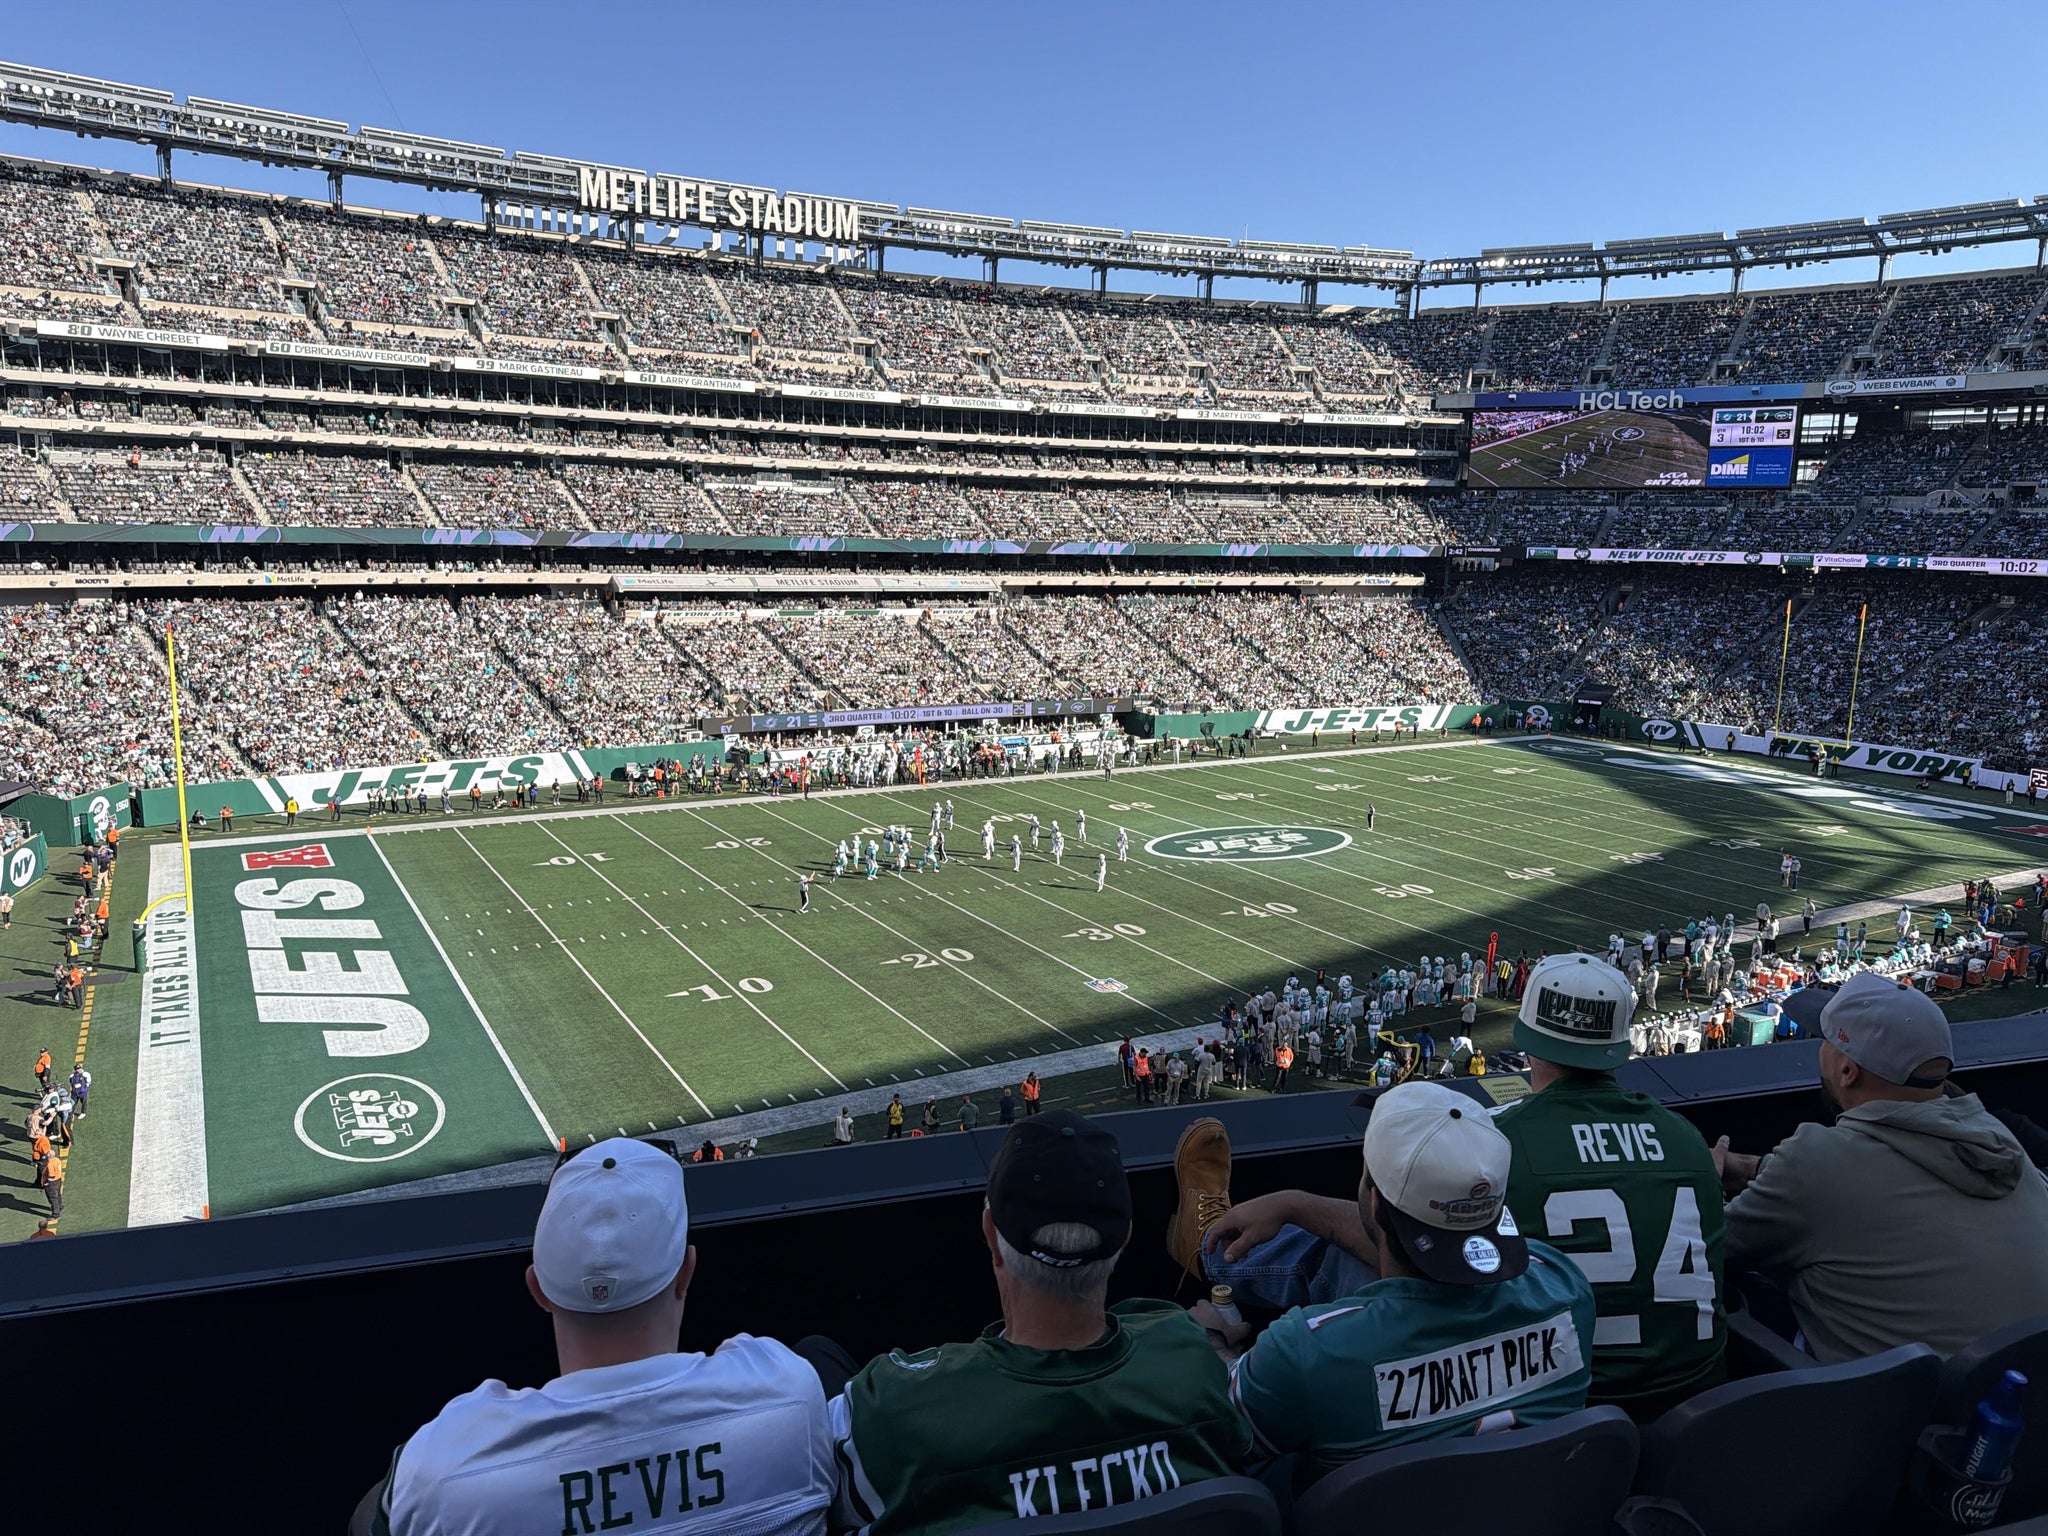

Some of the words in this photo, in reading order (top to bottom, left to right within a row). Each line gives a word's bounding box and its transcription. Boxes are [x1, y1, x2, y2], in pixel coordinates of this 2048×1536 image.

[580, 167, 717, 224] METLIFE
[728, 189, 859, 241] STADIUM
[67, 324, 92, 336] 80
[98, 326, 146, 342] WAYNE
[146, 330, 200, 346] CHREBET
[270, 342, 291, 353] 60
[295, 345, 373, 360] D'BRICKASHAW
[375, 353, 427, 364] FERGUSON
[476, 359, 495, 370] 99
[500, 362, 528, 373] MARK
[530, 365, 583, 377] GASTINEAU
[640, 373, 657, 383] 60
[660, 375, 690, 386] LARRY
[691, 379, 741, 390] GRANTHAM
[1863, 381, 1892, 390] WEEB
[1892, 379, 1937, 389] EWBANK
[834, 390, 854, 399] LEON
[855, 391, 876, 400] HESS
[927, 396, 940, 405] 75
[952, 398, 987, 407] WINSTON
[988, 400, 1003, 408] HILL
[1580, 389, 1684, 411] HCLTech
[1239, 412, 1262, 420] LYONS
[1352, 416, 1388, 424] MANGOLD
[1736, 413, 1747, 421] 21
[1717, 434, 1724, 442] 3
[1741, 426, 1765, 435] 10:02
[1710, 464, 1748, 475] DIME
[1671, 479, 1702, 487] CAM
[1608, 550, 1646, 559] NEW
[1647, 550, 1686, 561] YORK
[1687, 551, 1727, 562] JETS
[1896, 558, 1911, 568] 21
[1932, 559, 1949, 567] 3RD
[1950, 560, 1986, 568] QUARTER
[1999, 561, 2038, 573] 10:02
[277, 575, 305, 583] MetLife
[775, 577, 816, 587] METLIFE
[817, 578, 859, 587] STADIUM
[720, 725, 733, 734] EY
[787, 717, 801, 728] 21
[829, 714, 846, 723] 3RD
[847, 712, 883, 722] QUARTER
[890, 710, 917, 721] 10:02
[923, 710, 936, 718] 1ST
[944, 709, 952, 717] 10
[961, 707, 979, 716] BALL
[980, 707, 991, 715] ON
[993, 706, 1003, 714] 30
[1055, 703, 1062, 713] 7
[1865, 748, 1975, 778] YORK
[2031, 772, 2048, 787] 25
[12, 853, 33, 881] NY
[1371, 883, 1434, 898] 50
[155, 910, 187, 924] US
[1242, 902, 1298, 918] 40
[154, 924, 188, 943] OF
[1077, 923, 1147, 942] 30
[153, 945, 189, 971] ALL
[900, 947, 975, 970] 20
[234, 877, 431, 1057] JETS
[688, 977, 774, 1002] 10
[151, 973, 190, 1026] TAKES
[1553, 1009, 1595, 1024] JETS
[150, 1030, 190, 1047] IT
[349, 1089, 397, 1145] JETS
[1571, 1122, 1665, 1163] REVIS
[1031, 1250, 1082, 1267] JETS
[1544, 1186, 1716, 1345] 24
[1500, 1327, 1561, 1387] PICK
[1969, 1434, 1989, 1467] LIGHT
[559, 1441, 725, 1536] REVIS
